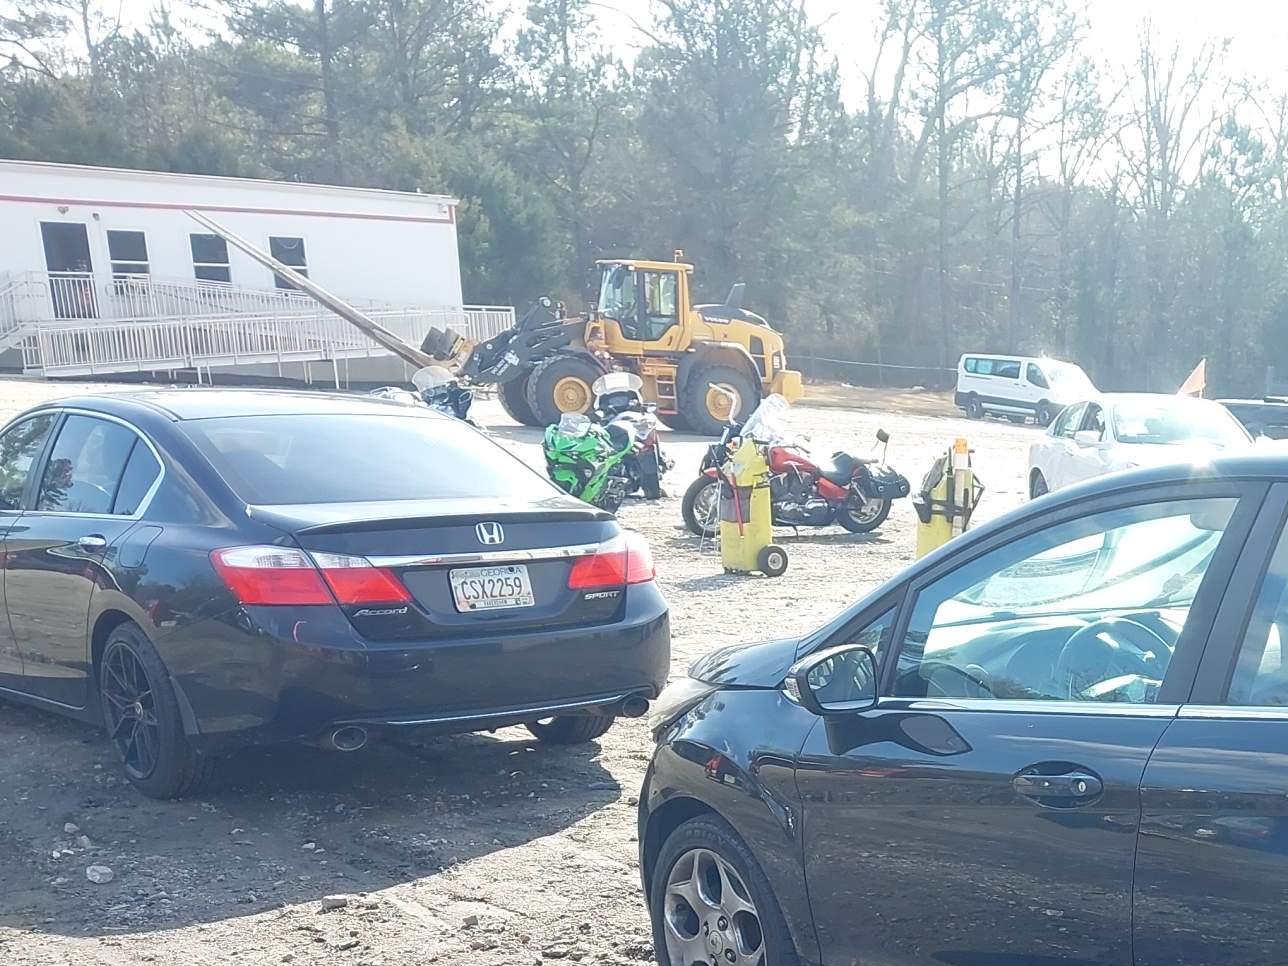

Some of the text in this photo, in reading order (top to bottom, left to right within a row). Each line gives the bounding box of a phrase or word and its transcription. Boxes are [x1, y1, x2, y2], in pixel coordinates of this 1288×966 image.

[461, 576, 522, 600] CSX2259
[583, 590, 620, 600] SPORT
[352, 606, 408, 617] Accord
